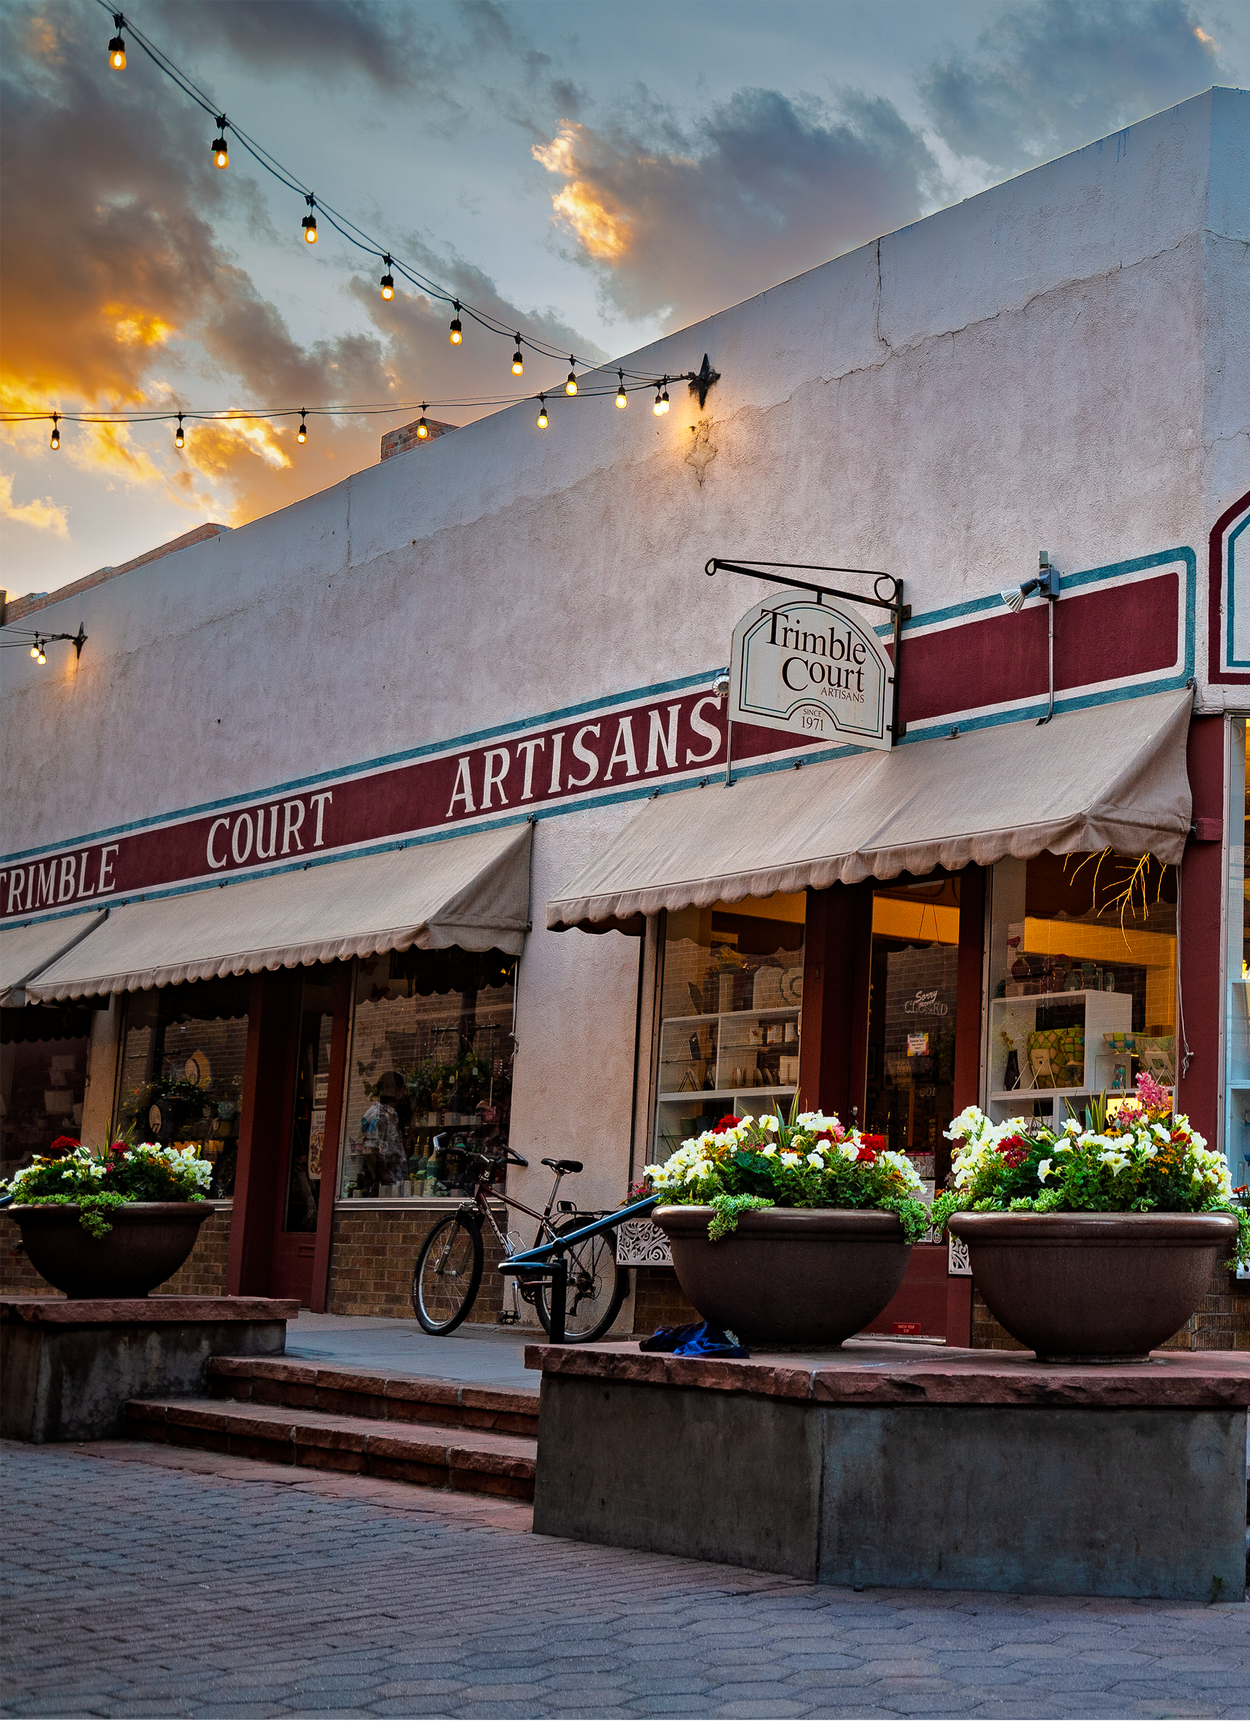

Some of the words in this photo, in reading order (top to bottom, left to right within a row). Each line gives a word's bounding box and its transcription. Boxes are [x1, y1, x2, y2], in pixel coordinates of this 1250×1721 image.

[760, 608, 867, 665] Trimble
[782, 656, 865, 693] Court
[821, 686, 865, 704] ARTISANS
[803, 708, 822, 718] SINCE
[801, 716, 824, 731] 1971
[206, 791, 333, 869] COURT
[446, 696, 722, 817] ARTISANS
[915, 990, 938, 1004] Sorry
